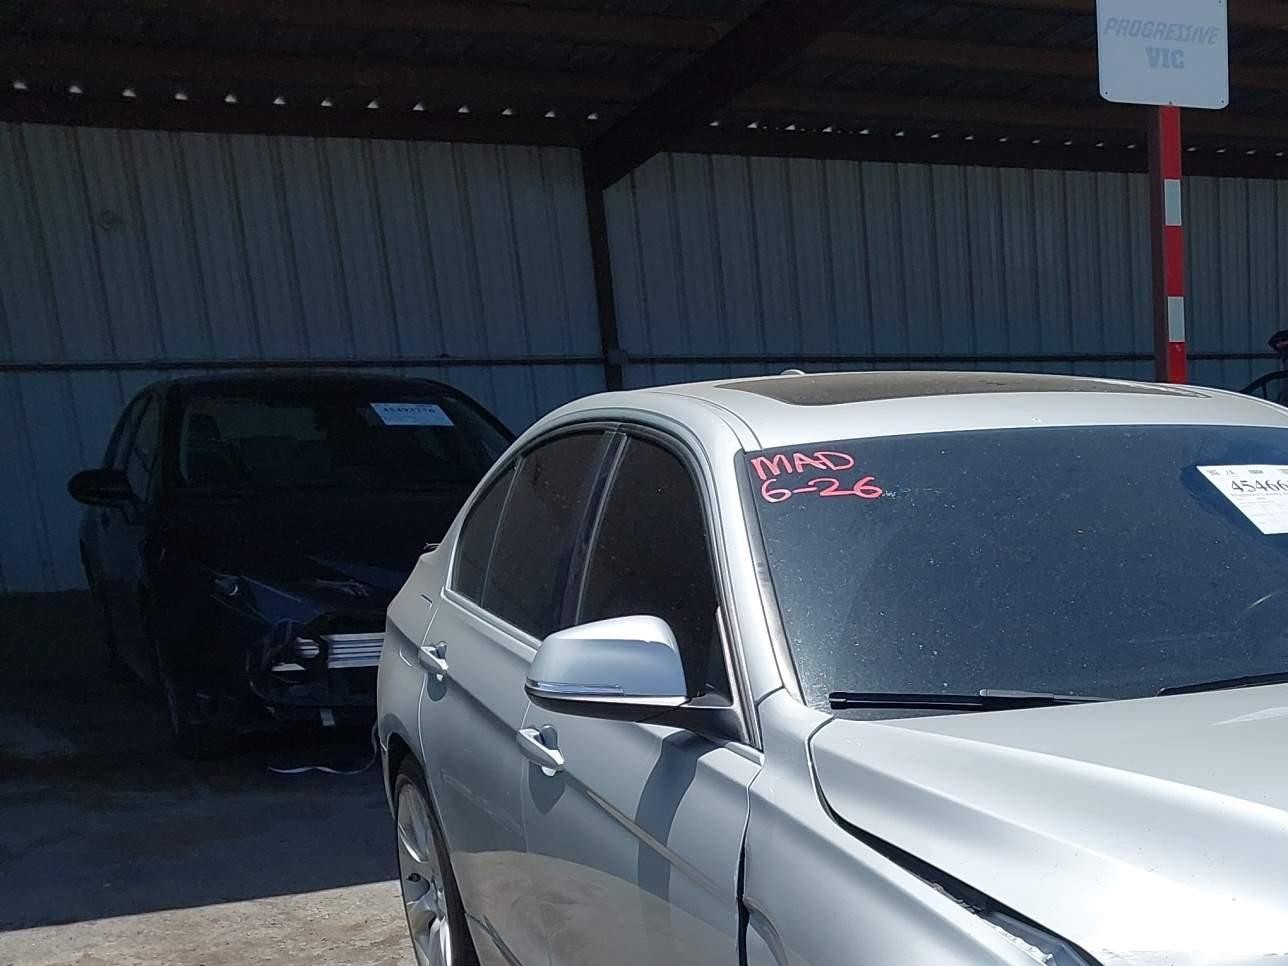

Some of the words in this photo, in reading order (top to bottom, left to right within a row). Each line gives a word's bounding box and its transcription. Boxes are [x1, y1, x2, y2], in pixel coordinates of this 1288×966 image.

[1104, 17, 1220, 45] PROGRESSIVE
[1145, 46, 1185, 69] VIC
[751, 451, 855, 480] MAD
[761, 477, 883, 503] 6-26
